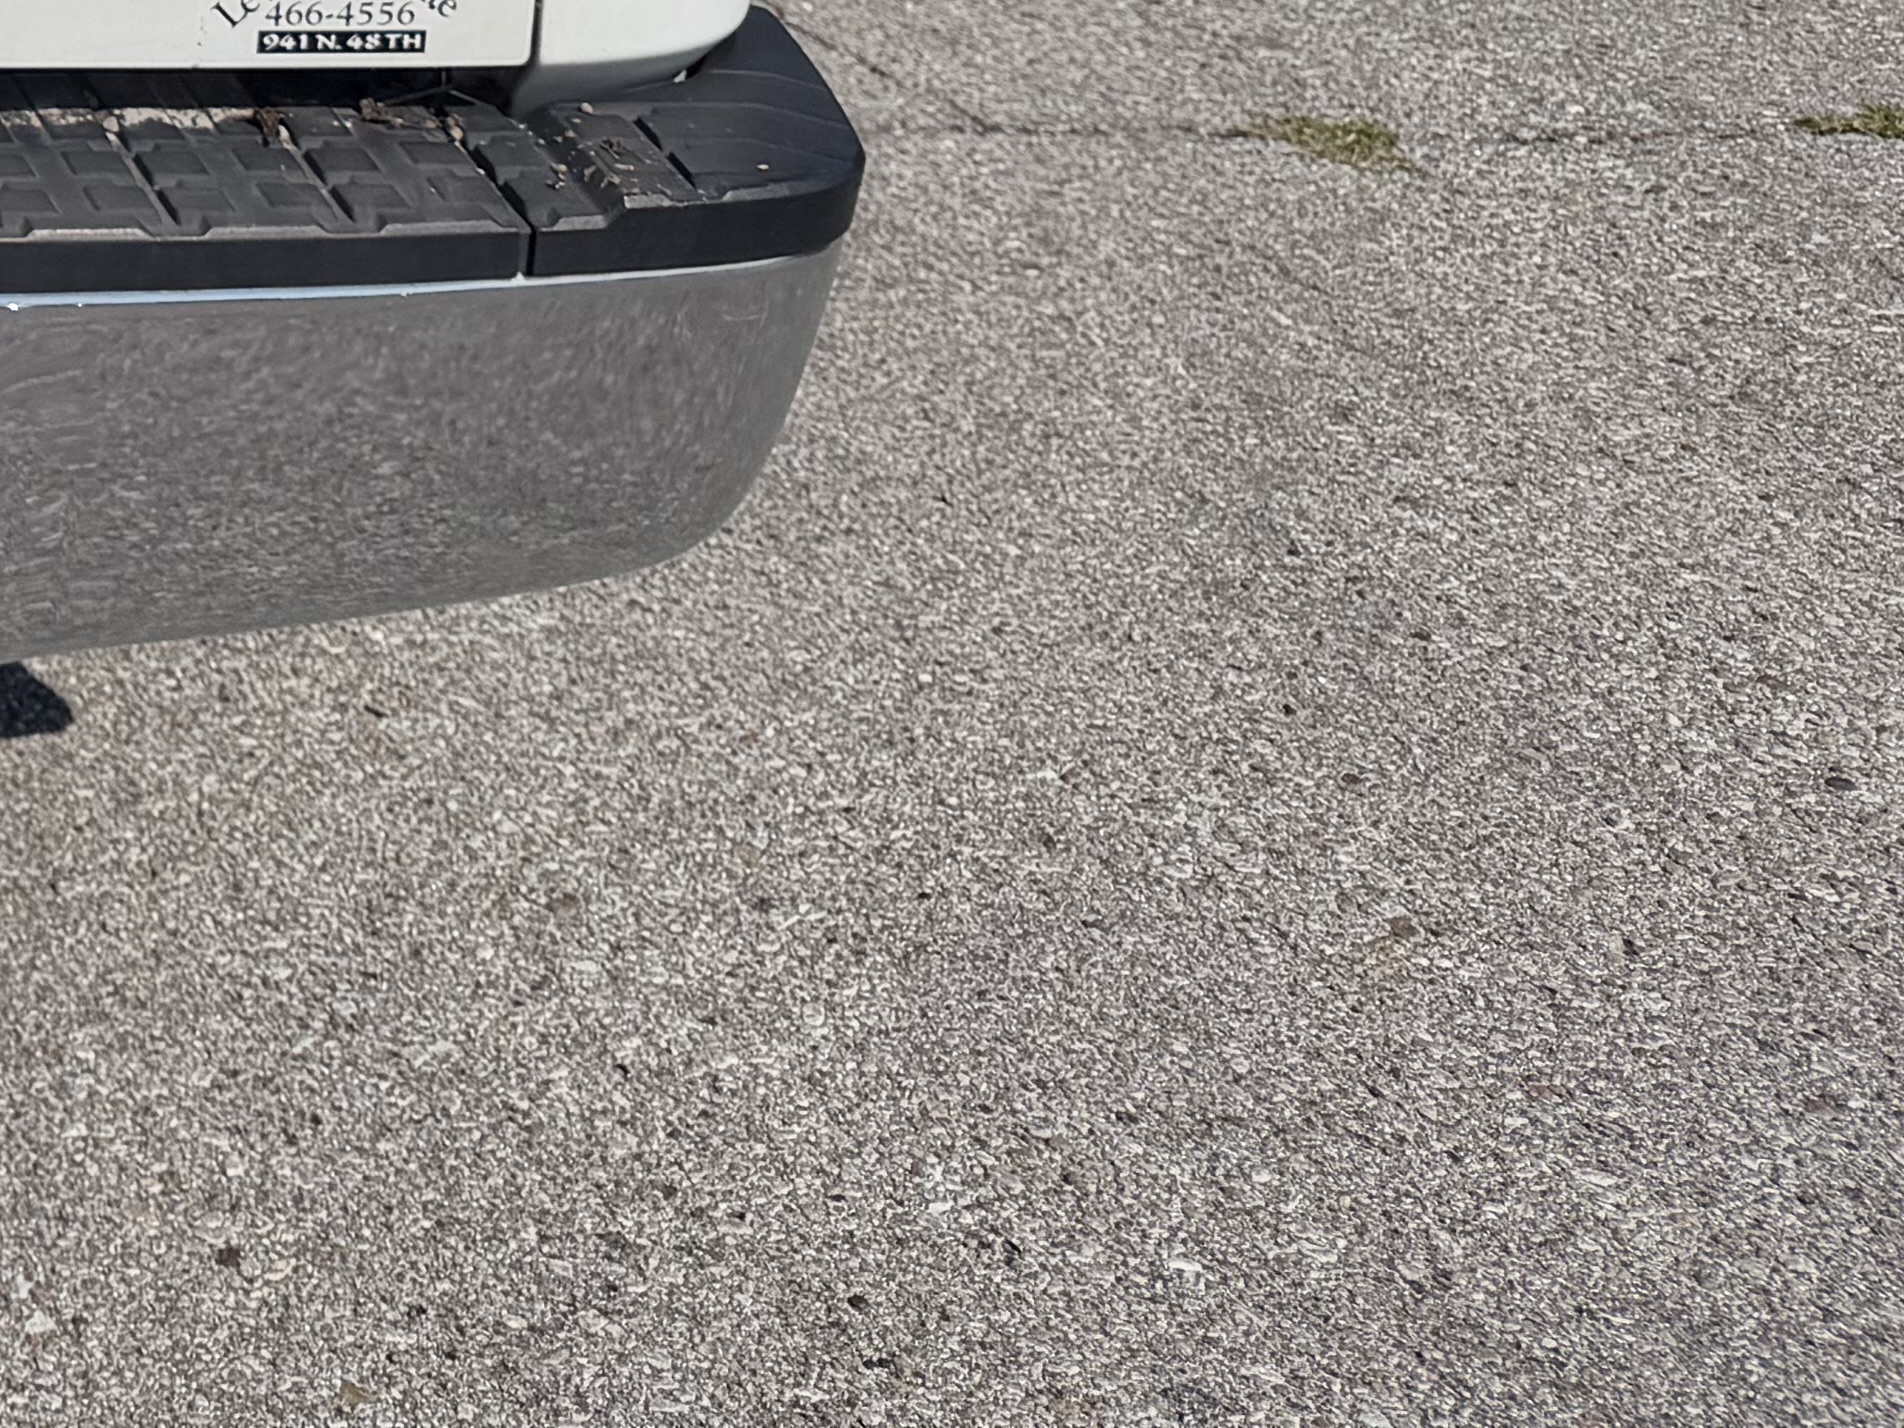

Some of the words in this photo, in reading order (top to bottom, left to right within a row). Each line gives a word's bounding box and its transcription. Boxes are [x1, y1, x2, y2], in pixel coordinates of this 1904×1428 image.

[265, 0, 416, 27] 466-4556
[262, 33, 309, 51] 941
[315, 33, 342, 51] N.
